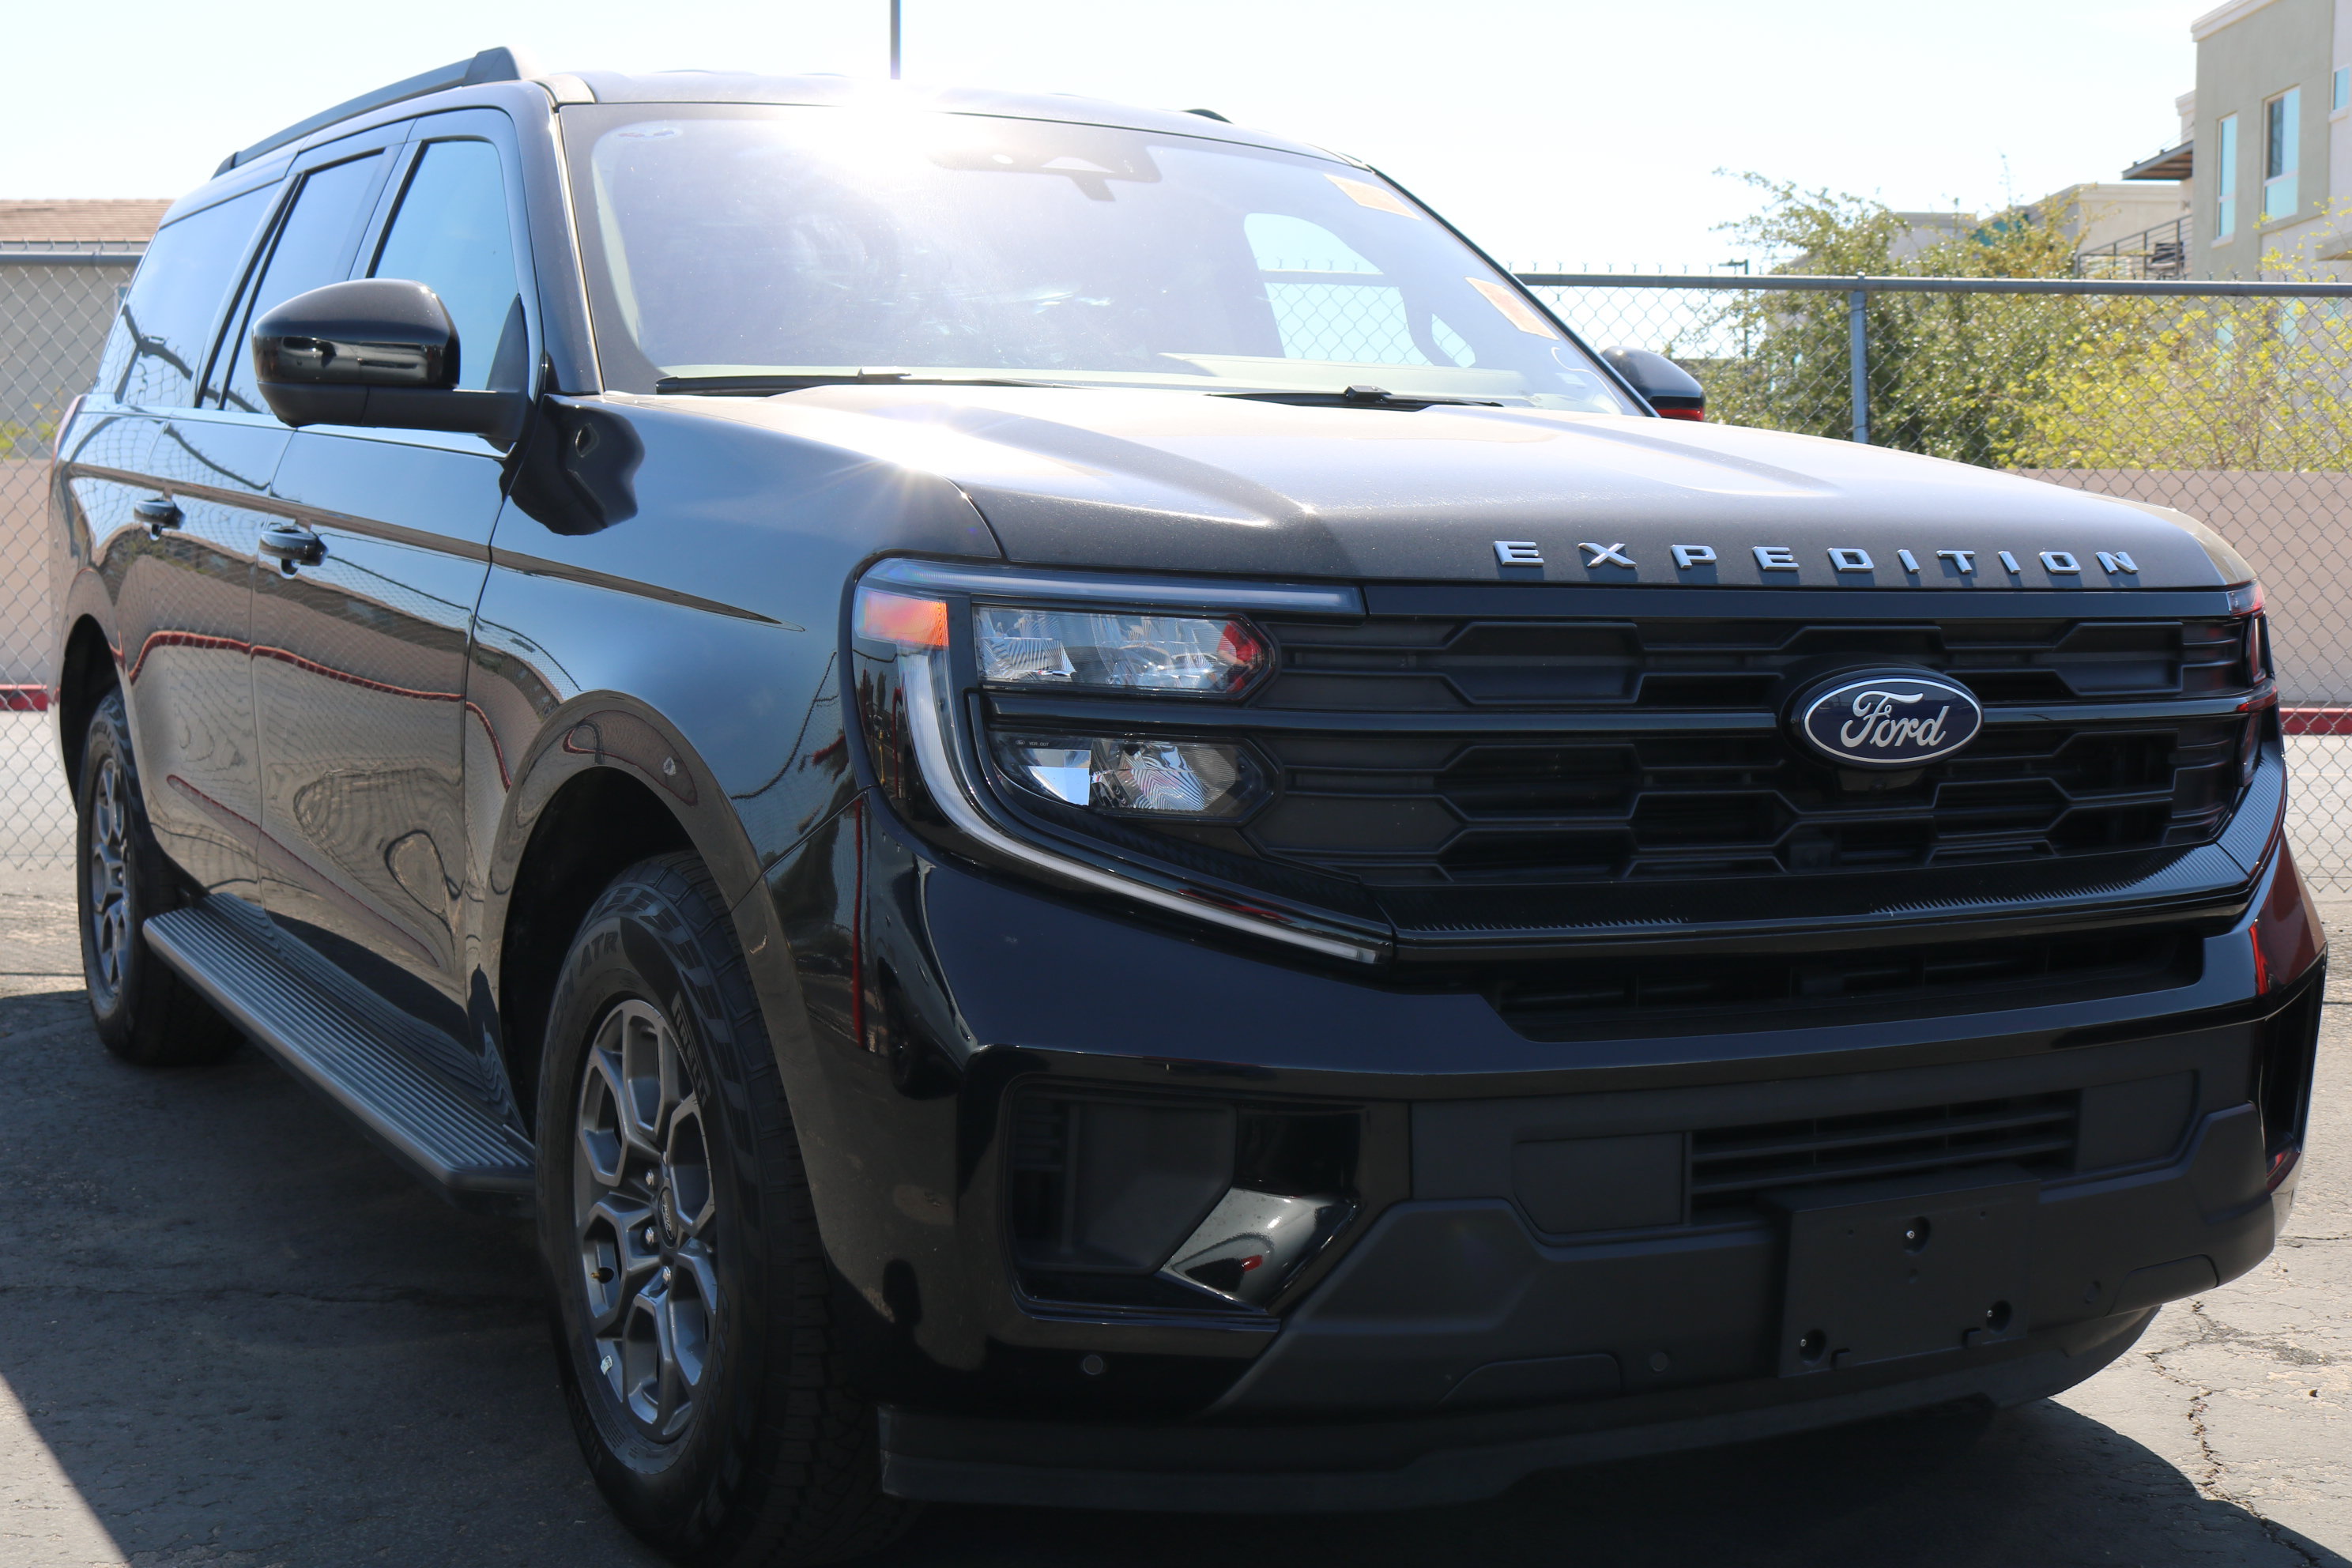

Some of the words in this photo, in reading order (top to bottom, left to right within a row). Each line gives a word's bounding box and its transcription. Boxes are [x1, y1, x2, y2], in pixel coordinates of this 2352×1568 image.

[1493, 540, 2139, 575] EXPEDITION
[1840, 689, 1951, 748] Ford
[579, 930, 619, 977] ATR
[670, 989, 712, 1108] PIRELLI
